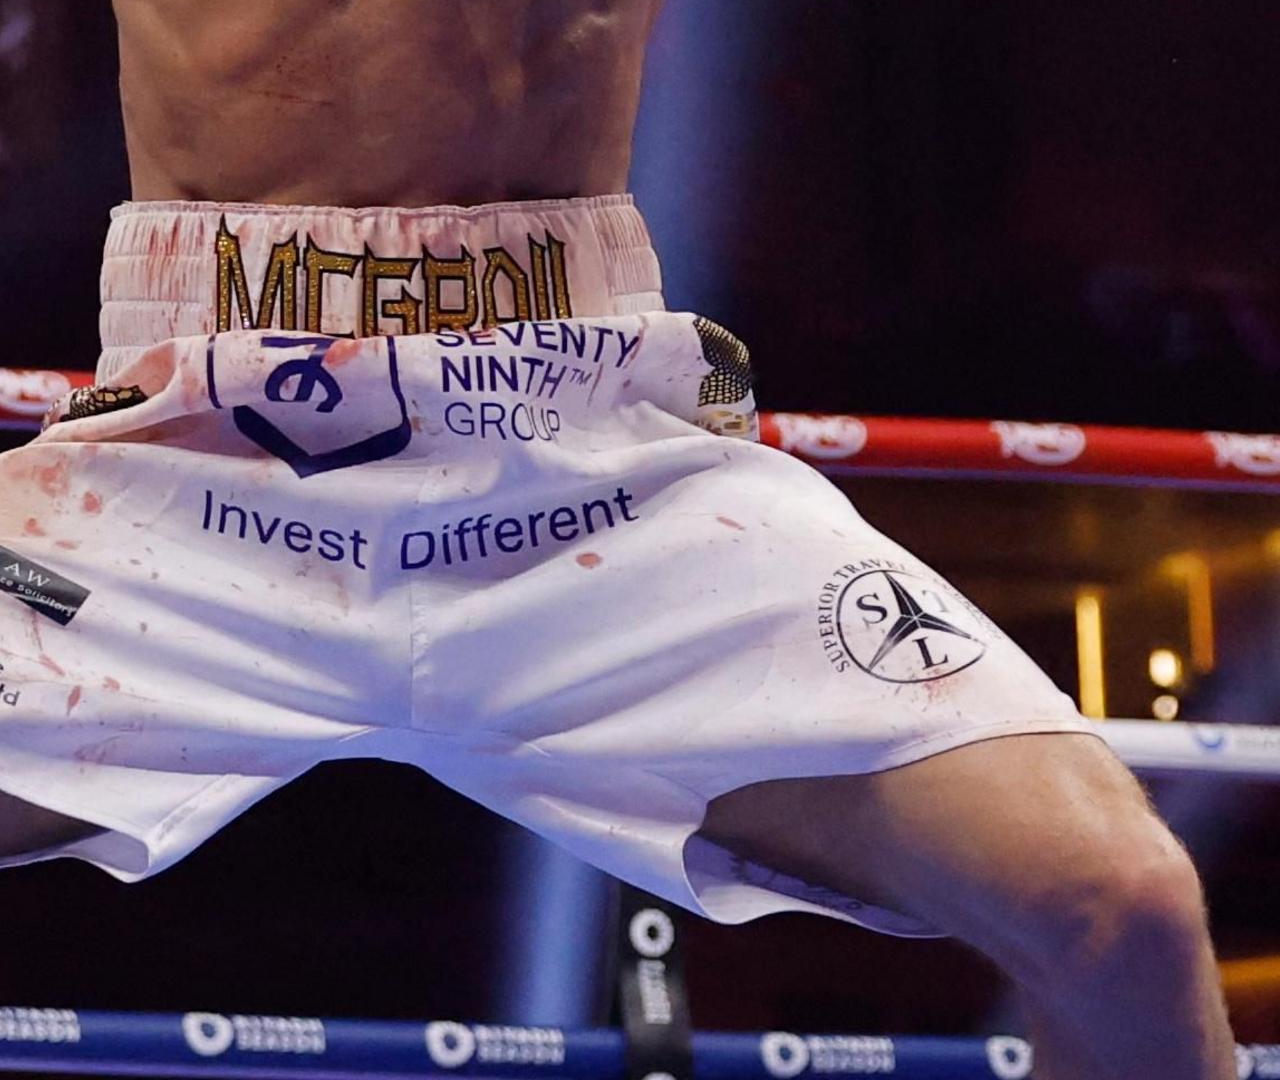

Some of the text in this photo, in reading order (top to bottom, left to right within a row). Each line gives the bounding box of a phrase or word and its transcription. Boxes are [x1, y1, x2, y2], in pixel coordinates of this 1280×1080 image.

[434, 323, 640, 376] SEVENTY
[442, 402, 562, 444] GROUP
[200, 486, 642, 572] Invest Different
[818, 582, 851, 673] SUPERIOR
[855, 591, 889, 626] S
[911, 636, 950, 671] L
